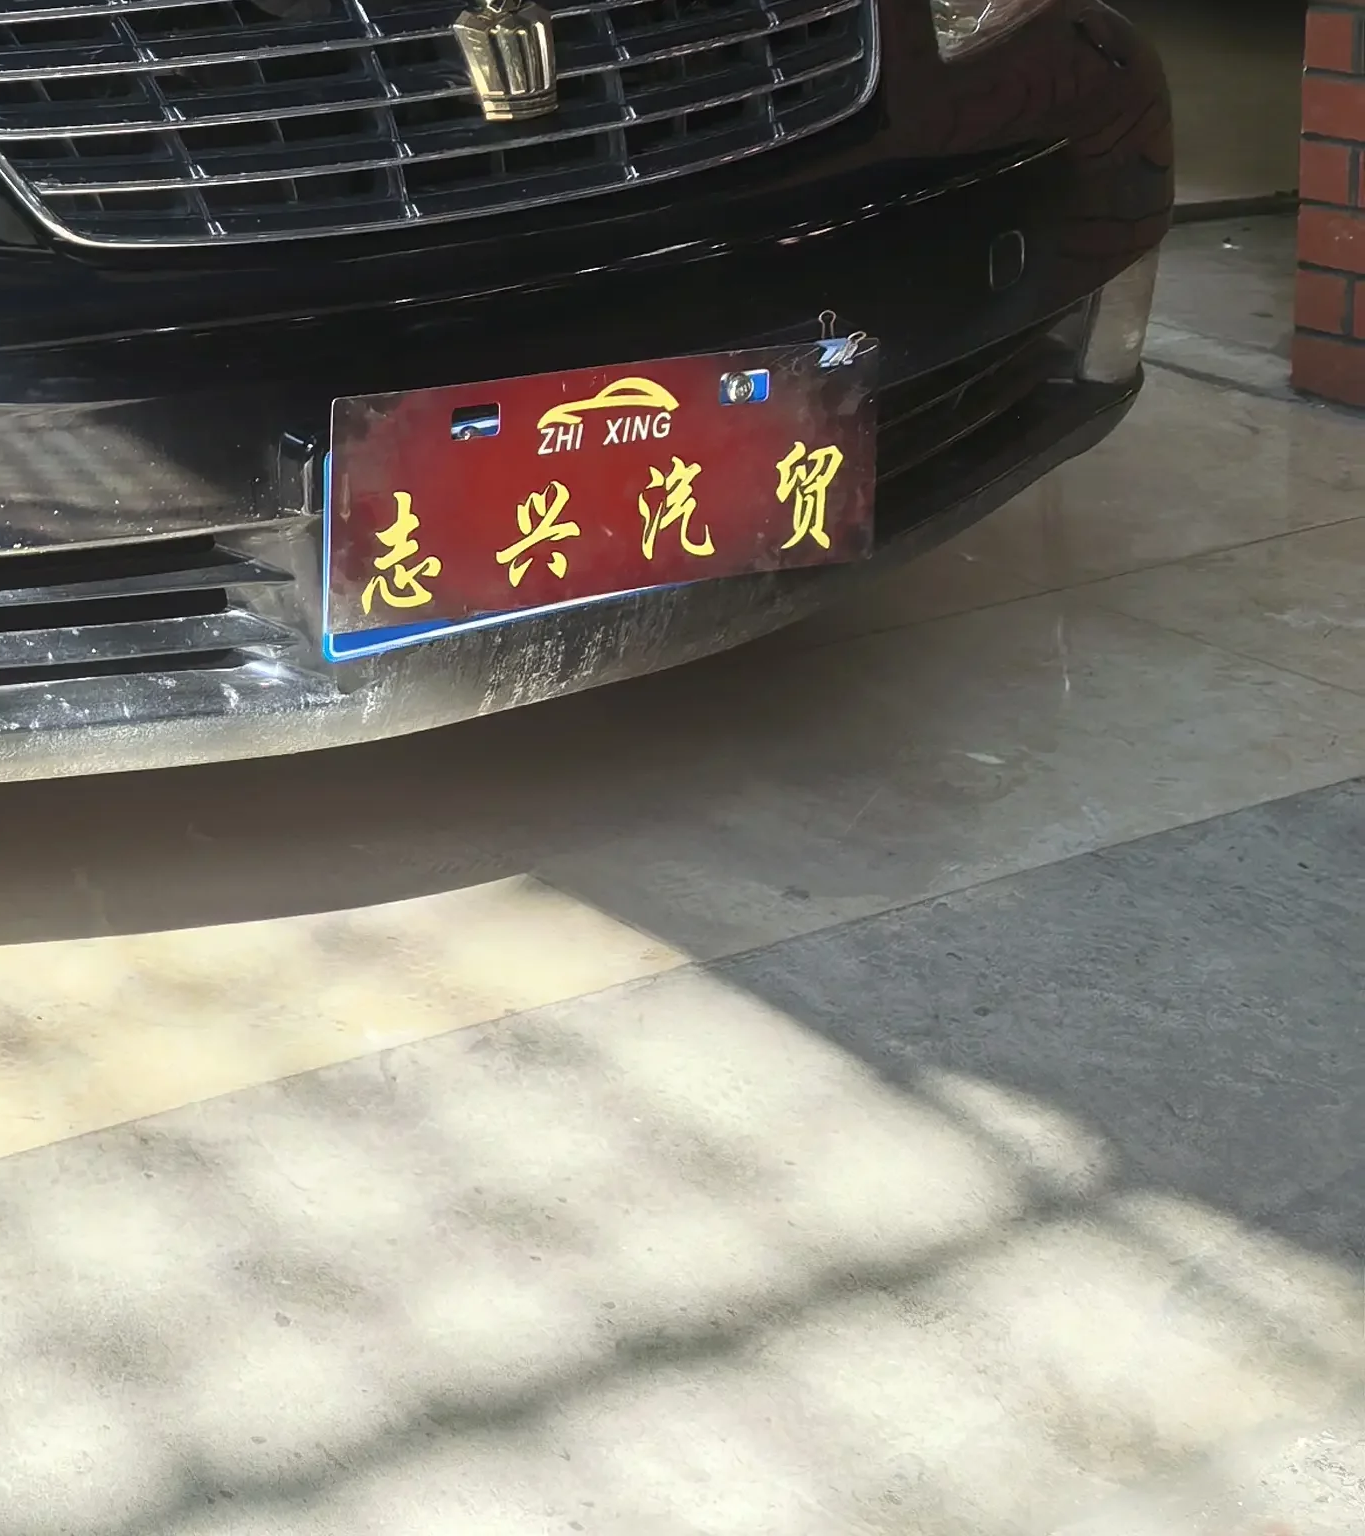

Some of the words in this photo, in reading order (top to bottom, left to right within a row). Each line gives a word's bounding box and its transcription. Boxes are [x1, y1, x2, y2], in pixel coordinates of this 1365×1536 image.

[537, 423, 584, 456] ZHI
[602, 411, 672, 446] XING
[361, 441, 844, 614] 志兴汽贸
